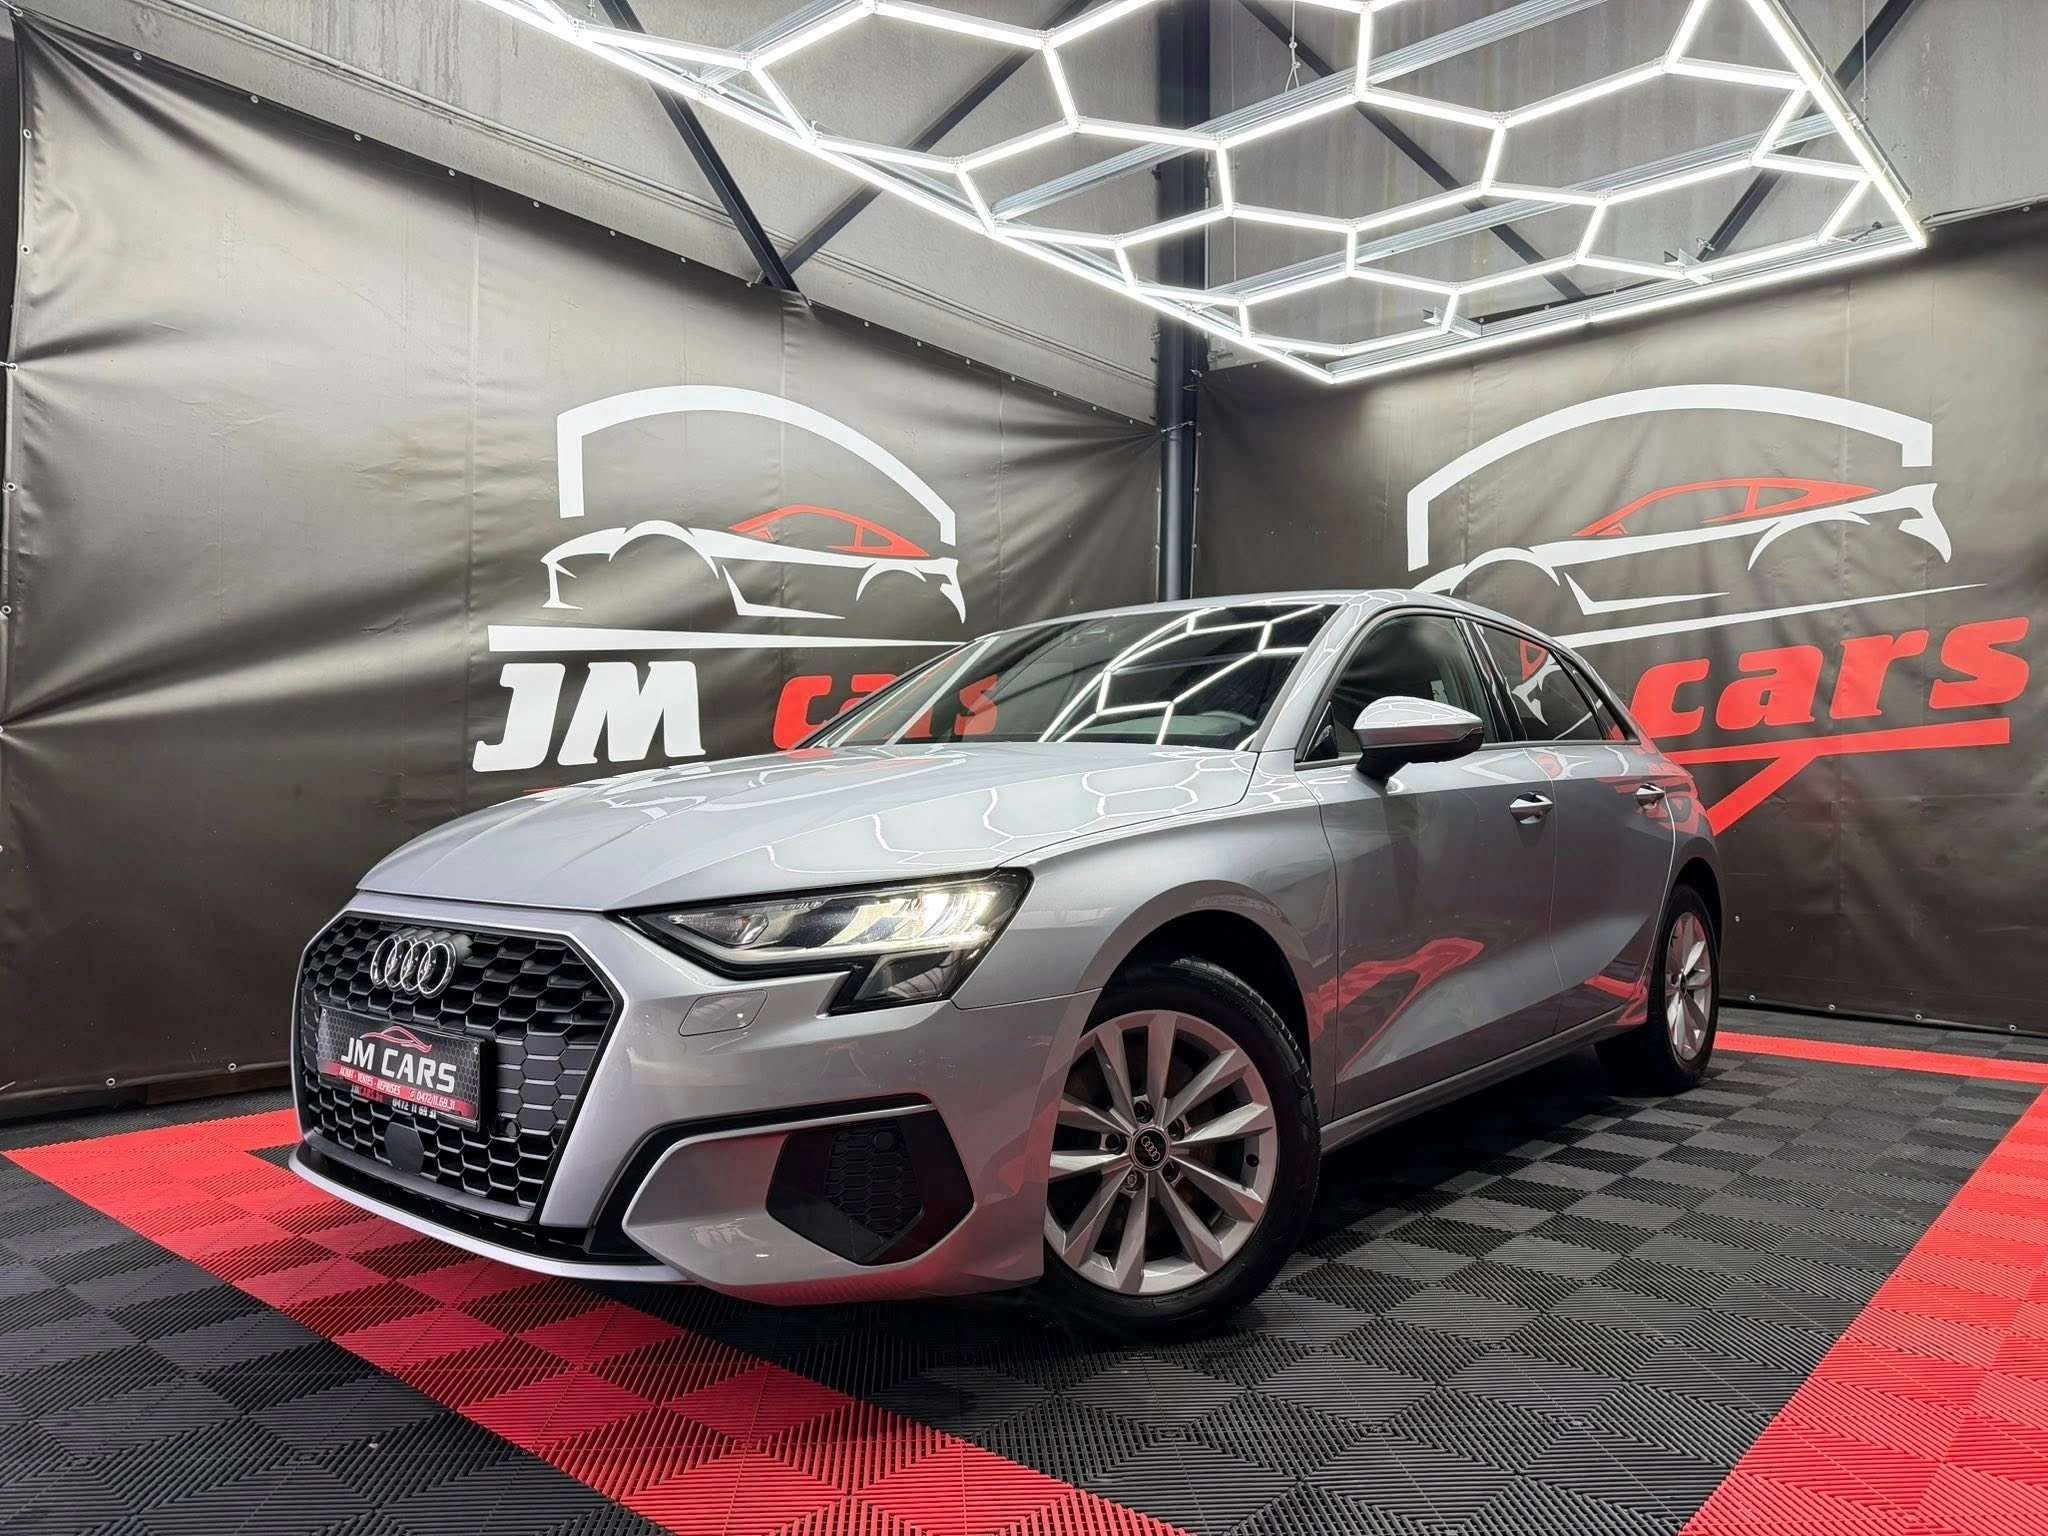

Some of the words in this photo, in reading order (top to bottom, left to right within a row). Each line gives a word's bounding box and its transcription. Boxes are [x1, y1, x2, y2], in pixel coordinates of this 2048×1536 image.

[472, 661, 706, 772] JM
[1624, 617, 2031, 739] cars
[341, 1037, 376, 1071] JM
[381, 1047, 457, 1093] CARS
